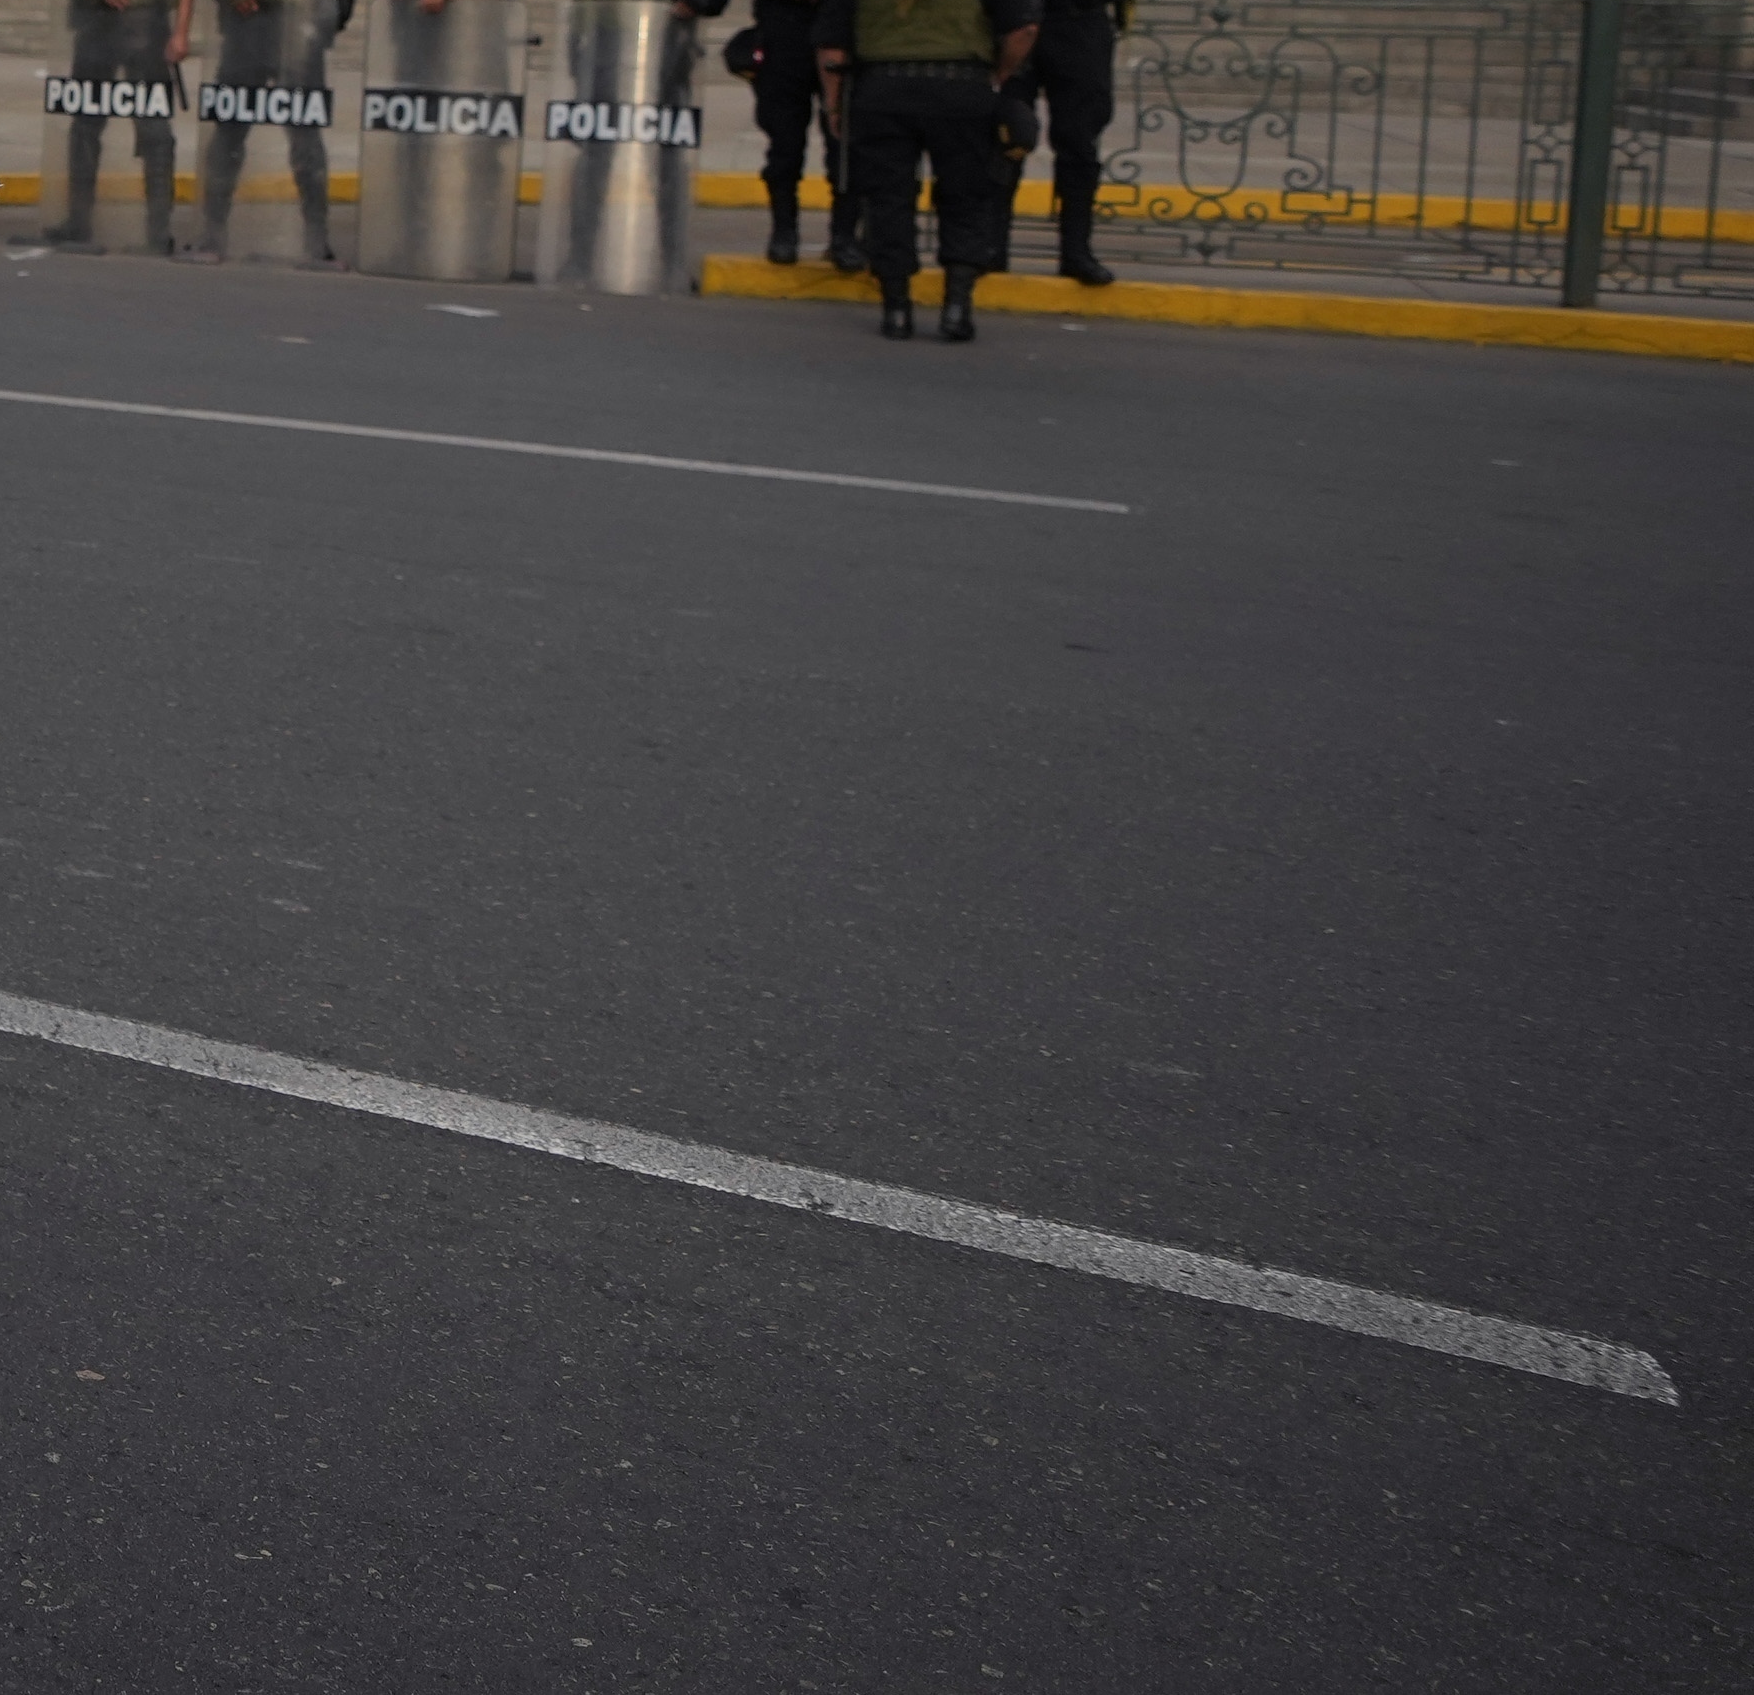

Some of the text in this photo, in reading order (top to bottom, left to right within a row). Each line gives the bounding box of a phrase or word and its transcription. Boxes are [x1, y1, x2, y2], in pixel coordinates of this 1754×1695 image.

[47, 78, 171, 118] POLICIA
[201, 85, 329, 126] POLICIA
[364, 93, 519, 138] POLICIA
[548, 103, 697, 146] POLICIA
